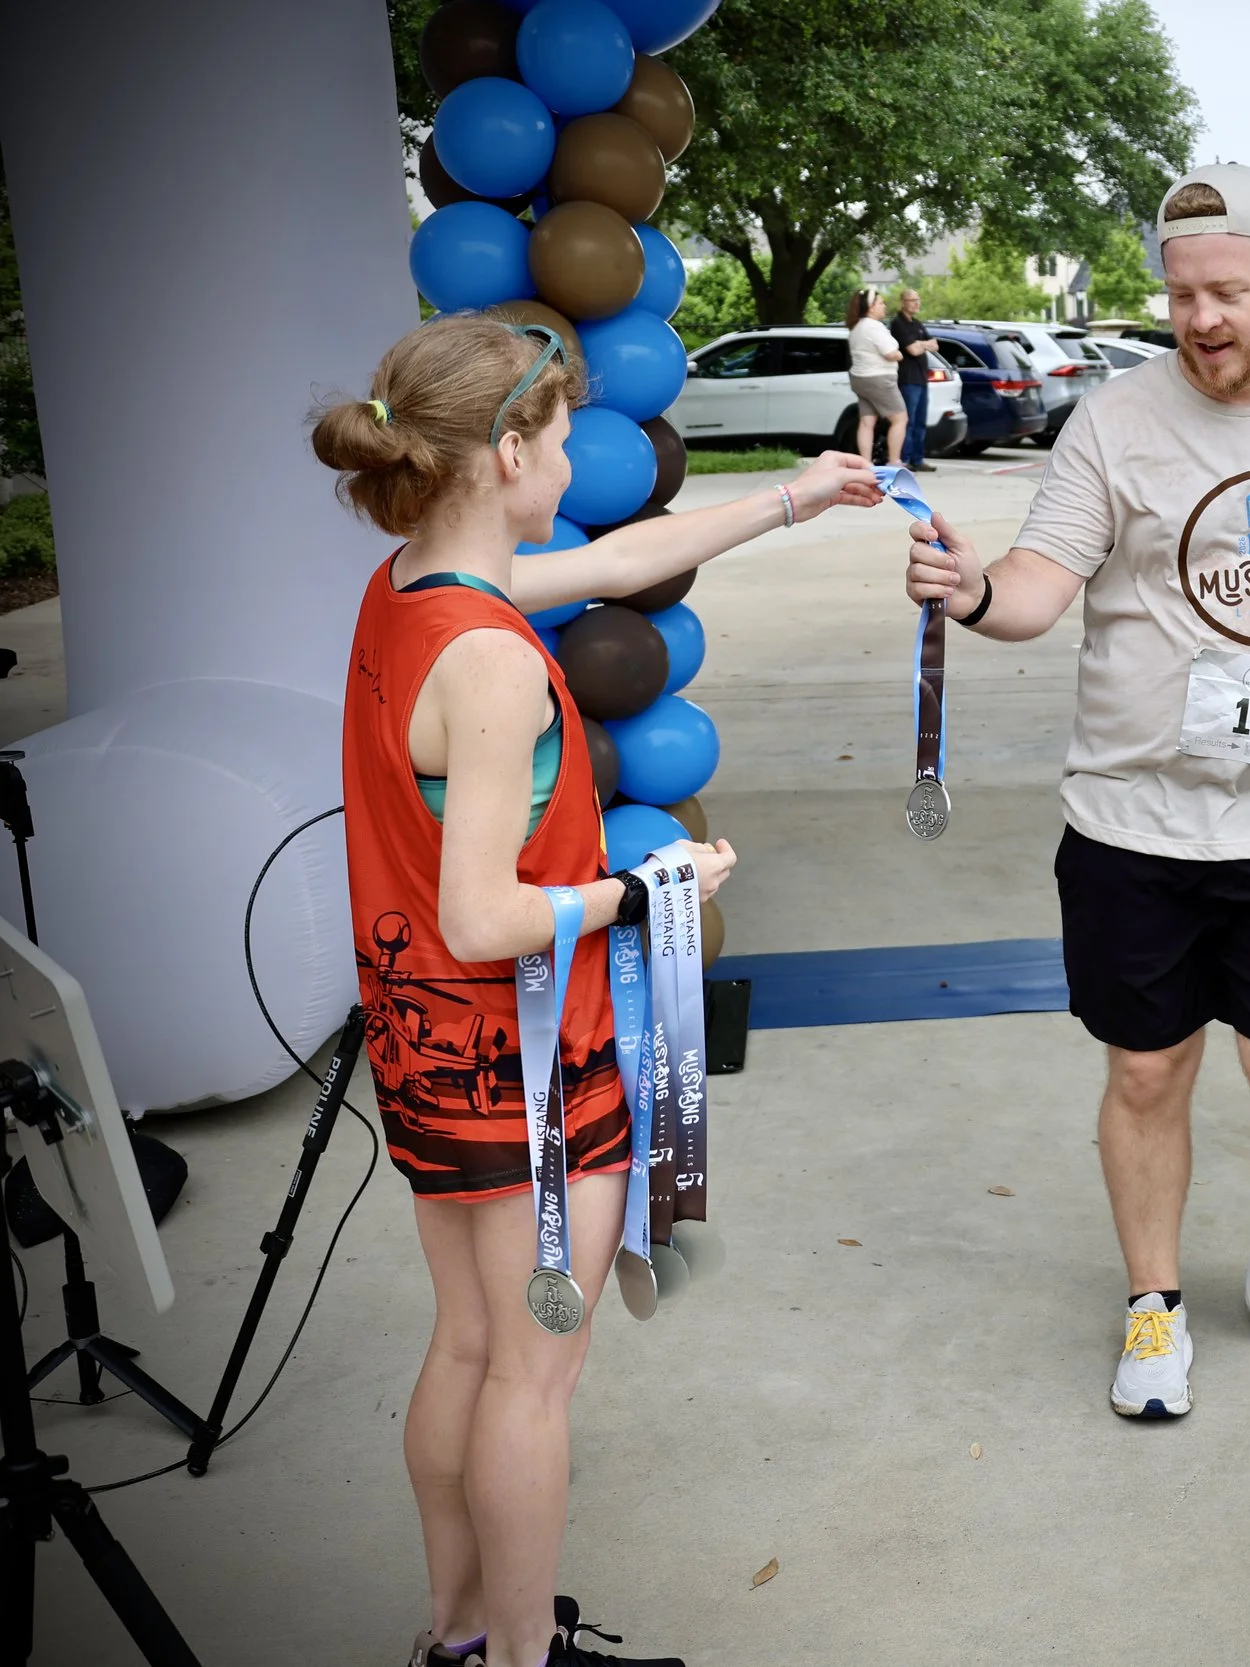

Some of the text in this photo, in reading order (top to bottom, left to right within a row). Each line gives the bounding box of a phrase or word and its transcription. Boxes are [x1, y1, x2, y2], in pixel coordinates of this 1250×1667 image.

[1194, 736, 1228, 749] Results
[615, 926, 640, 984] STANG
[663, 891, 674, 957] MUSTANG
[676, 898, 687, 951] LAKES
[683, 888, 696, 956] MUSTANG
[638, 1030, 653, 1111] MUSTANG
[653, 1022, 670, 1100] MUSTANG
[679, 1049, 703, 1124] MUSTANG
[307, 1056, 342, 1138] PROLINE
[540, 1191, 563, 1269] MUSTANG
